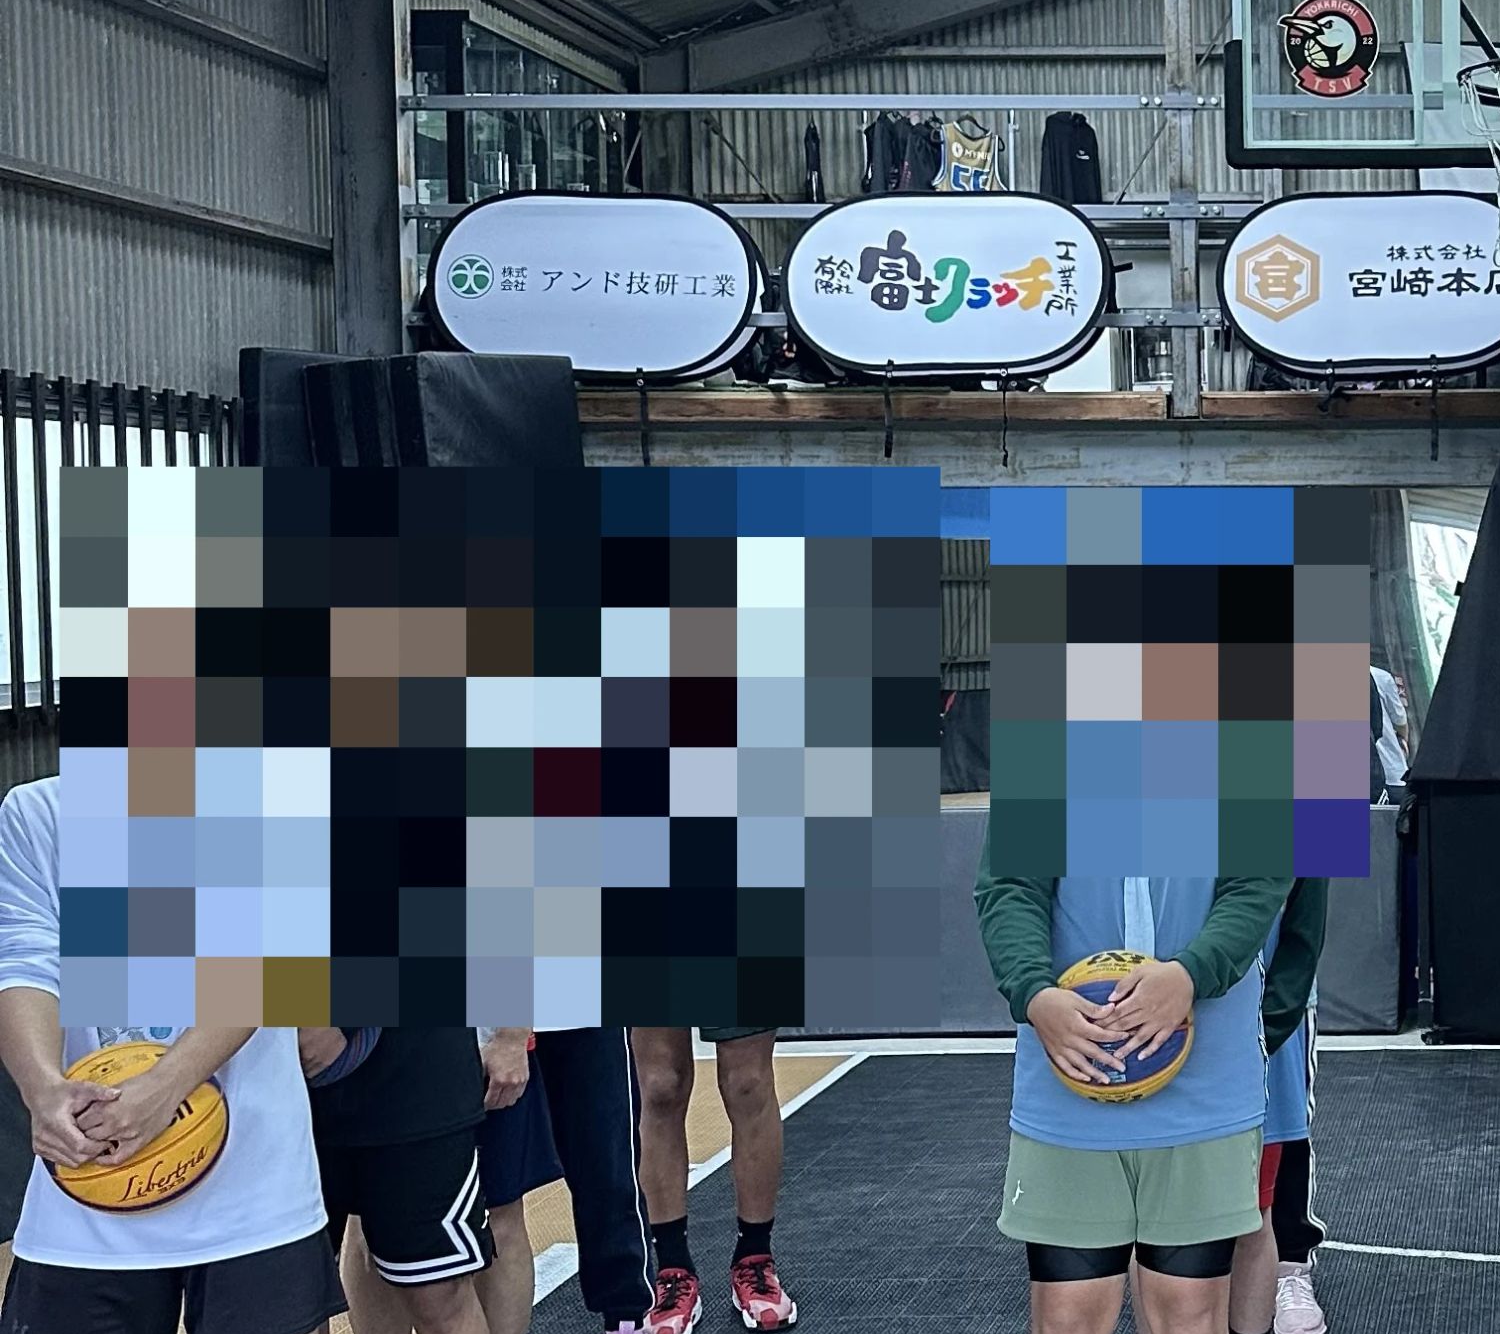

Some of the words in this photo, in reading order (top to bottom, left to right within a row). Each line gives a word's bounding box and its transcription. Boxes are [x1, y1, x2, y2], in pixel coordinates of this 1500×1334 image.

[1362, 37, 1373, 45] 22
[1386, 244, 1487, 261] 株式会社
[541, 270, 736, 297] アンド技研工業
[857, 230, 1055, 323] 富士クラッチ
